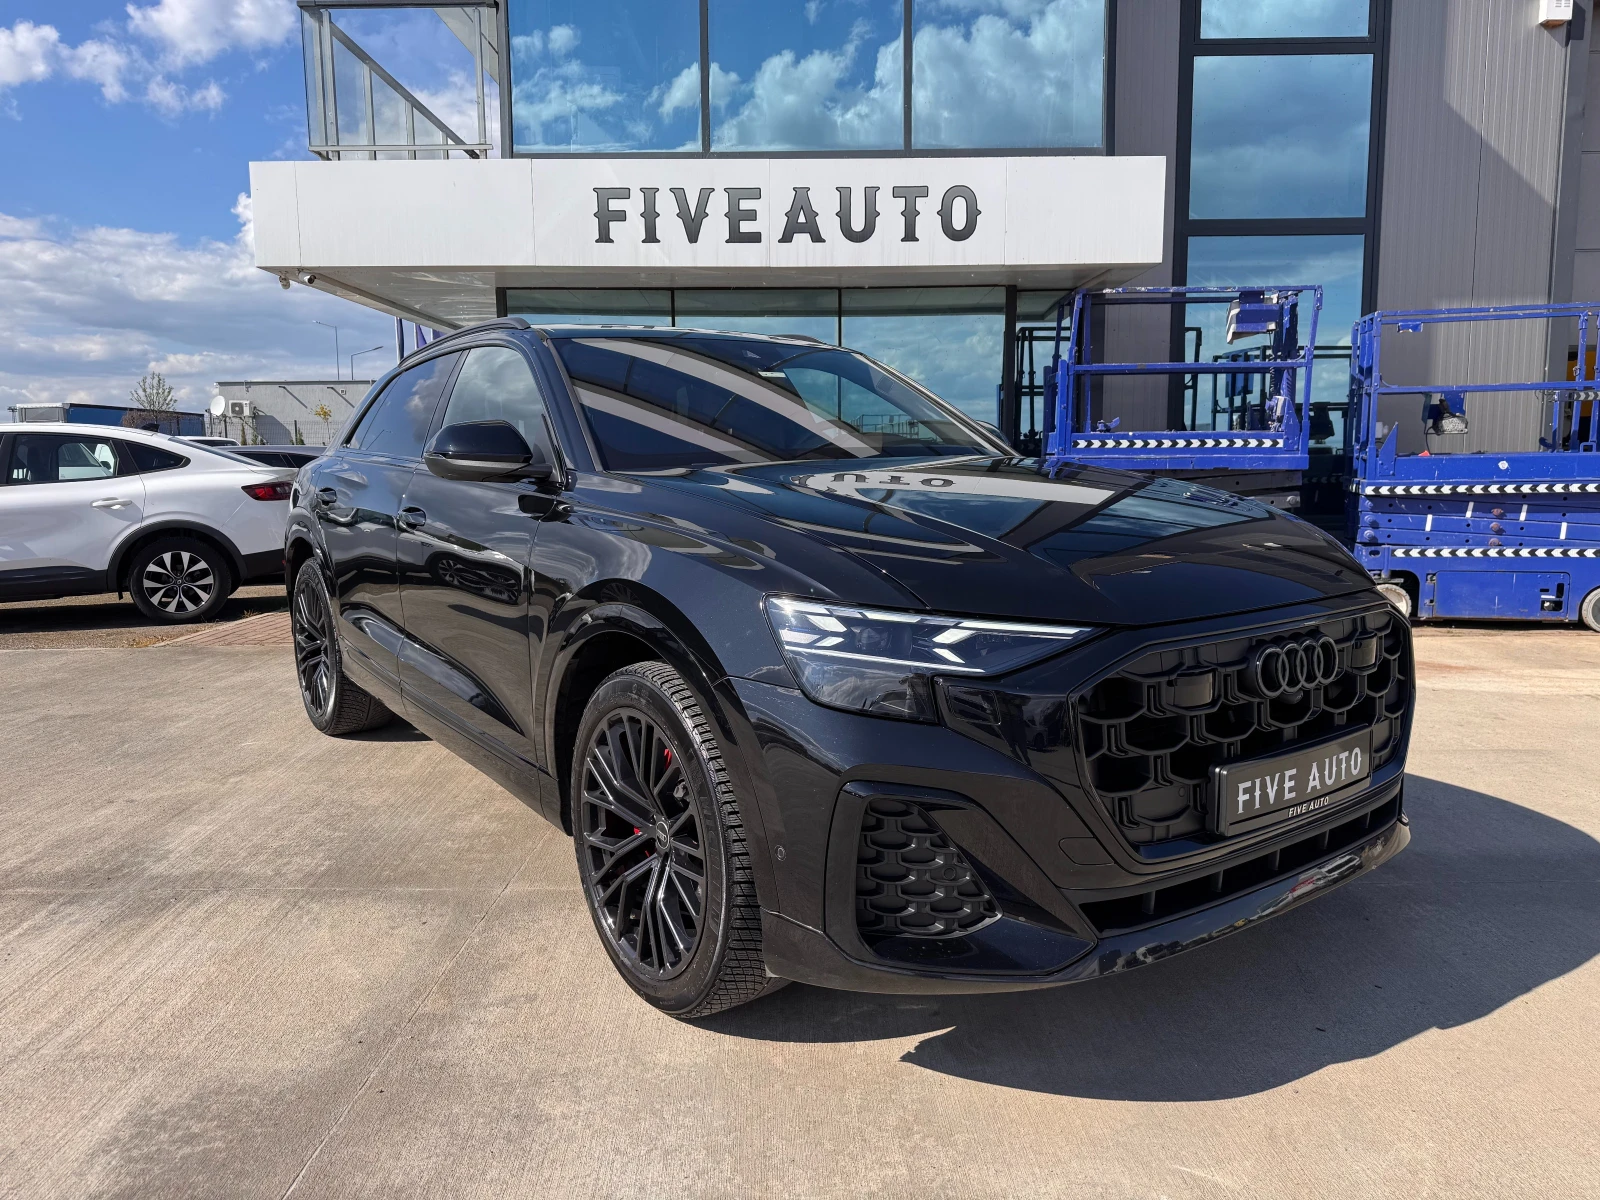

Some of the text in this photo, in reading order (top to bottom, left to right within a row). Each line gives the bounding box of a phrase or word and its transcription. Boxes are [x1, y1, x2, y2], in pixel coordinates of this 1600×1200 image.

[593, 185, 982, 244] FIVE AUTO
[1237, 747, 1362, 814] FIVE AUTO
[1288, 796, 1329, 817] FIVE AUTO
